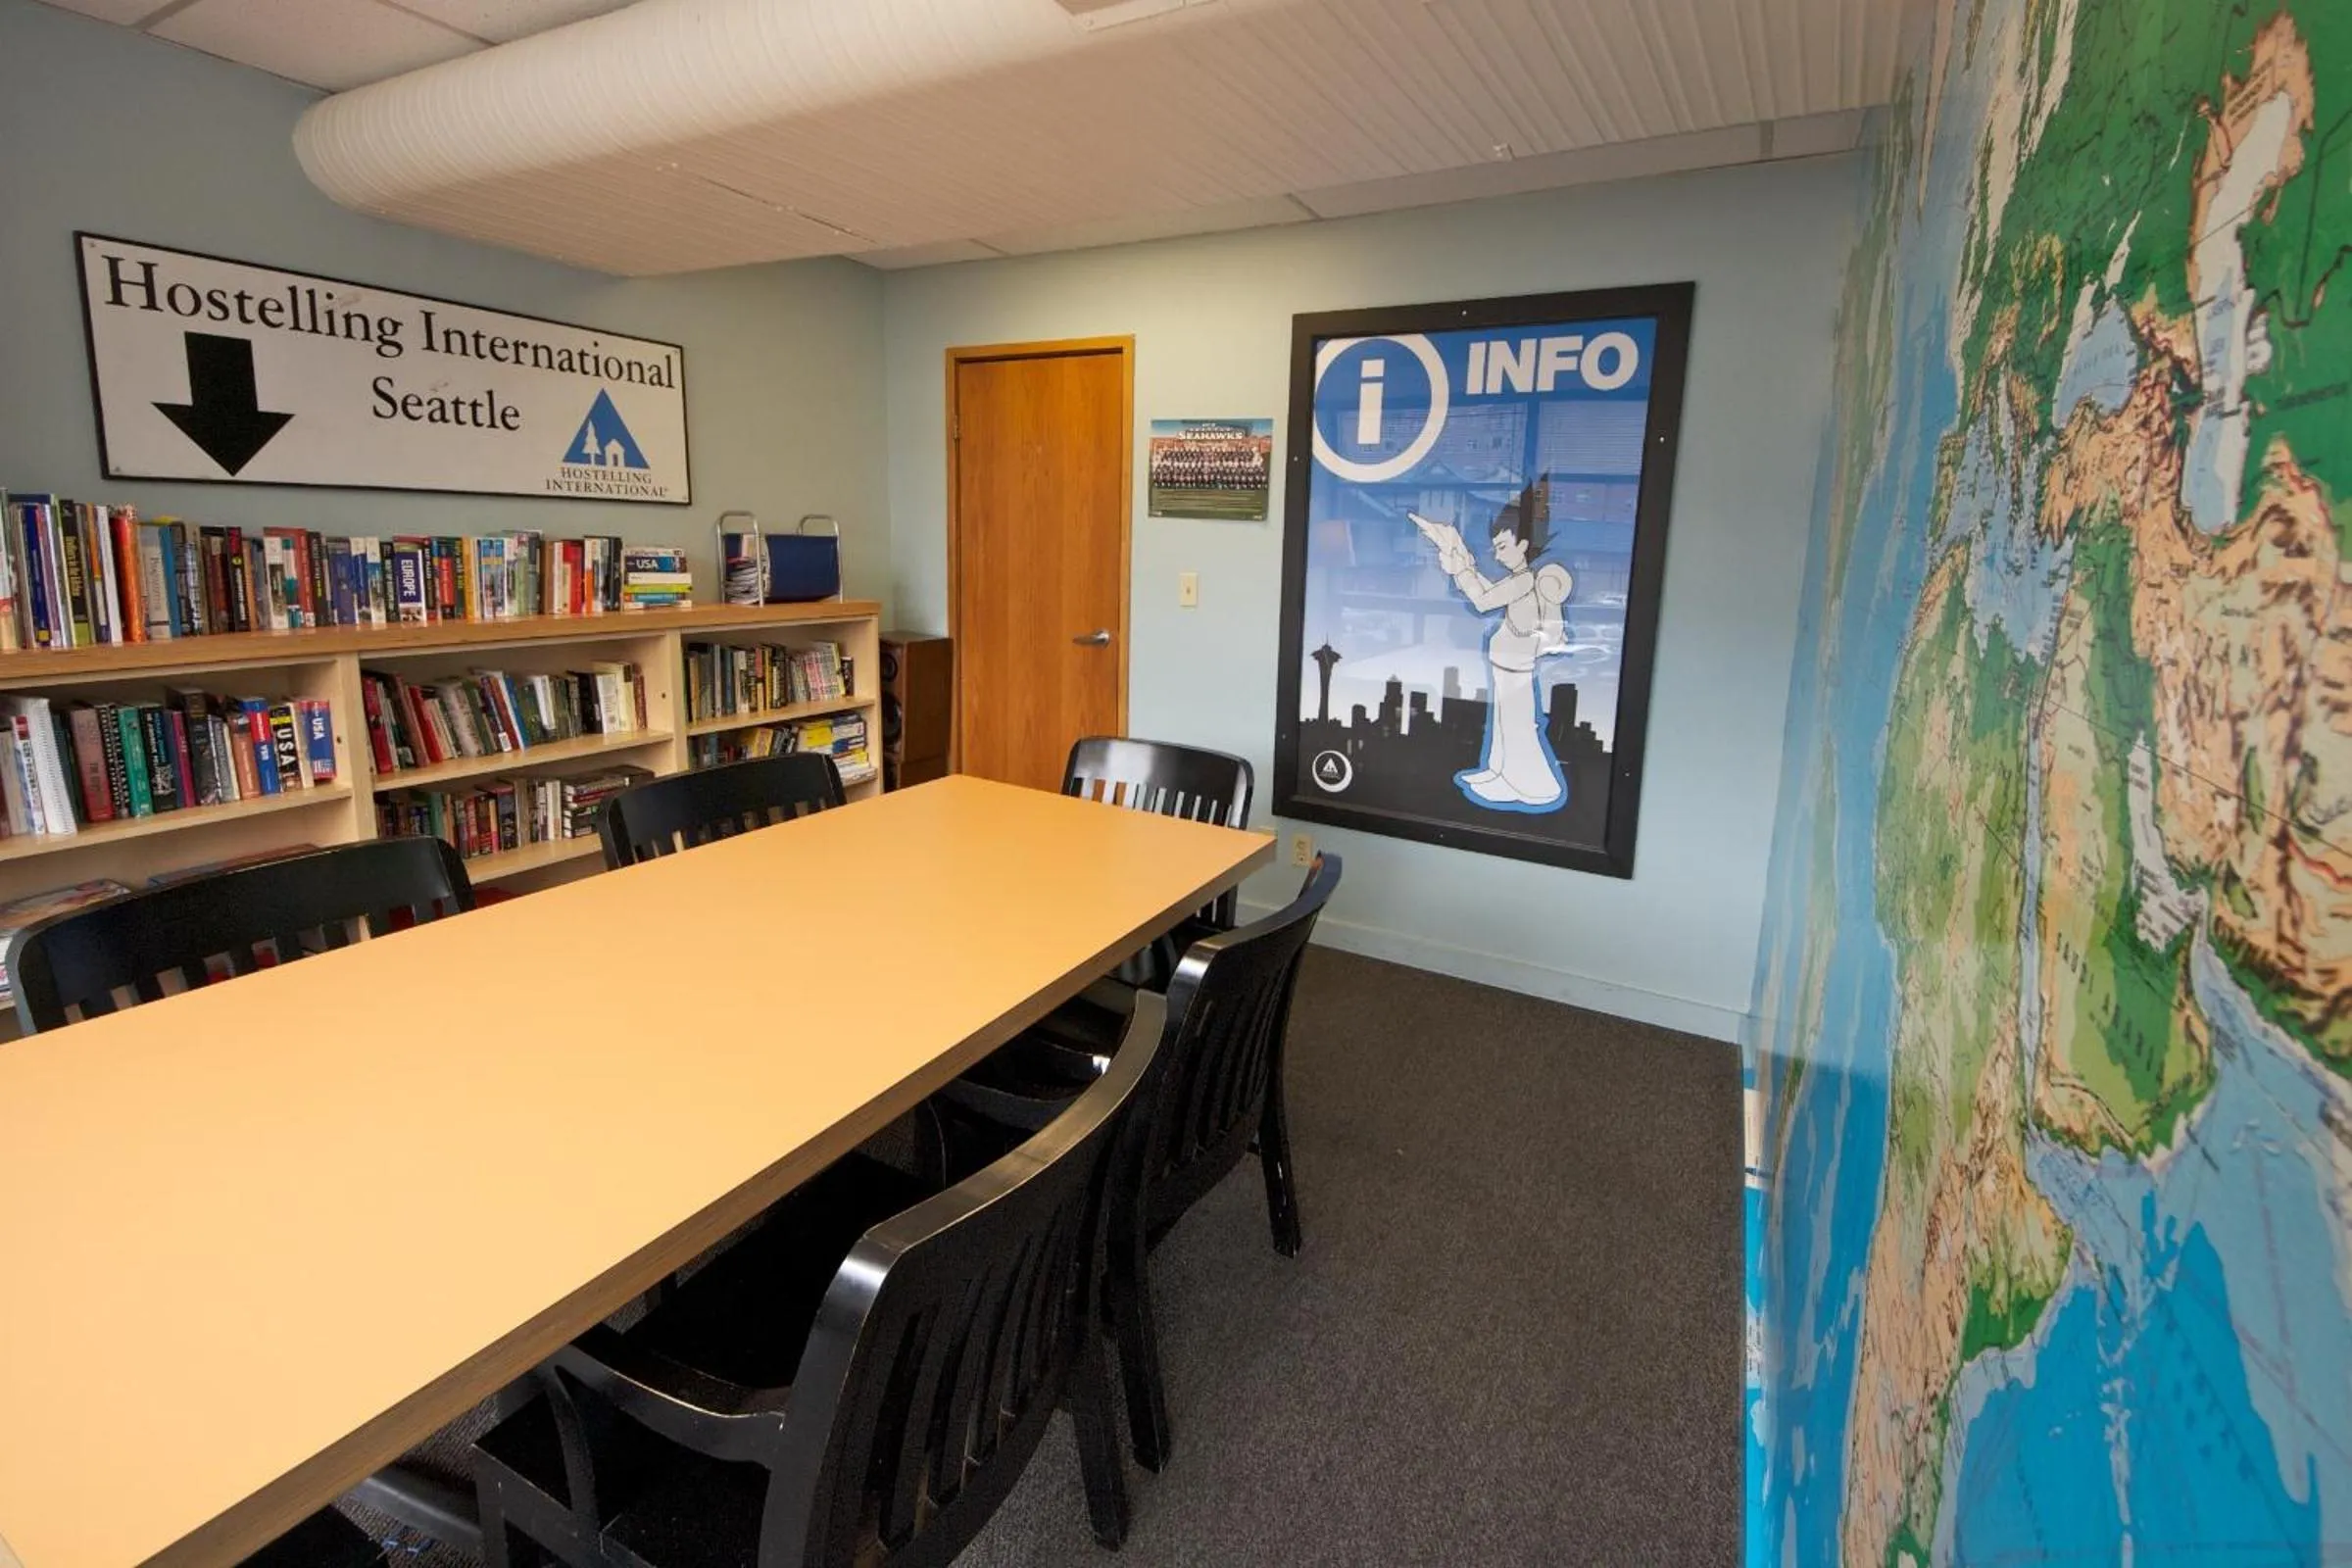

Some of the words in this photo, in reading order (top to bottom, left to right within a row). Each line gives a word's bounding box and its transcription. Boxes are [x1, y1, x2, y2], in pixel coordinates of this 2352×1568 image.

[101, 254, 403, 358] Hostelling
[419, 309, 675, 389] International
[1465, 331, 1640, 396] INFO
[371, 375, 521, 431] Seattle
[1357, 358, 1385, 445] i
[1178, 431, 1244, 440] SEAHAWKS
[545, 479, 667, 498] INTERNATIONAL
[561, 466, 652, 484] HOSTELLING
[401, 559, 416, 597] EUROPE
[636, 559, 659, 570] USA
[277, 727, 295, 767] USA
[312, 717, 323, 741] USA
[2055, 931, 2095, 995] SAUDI
